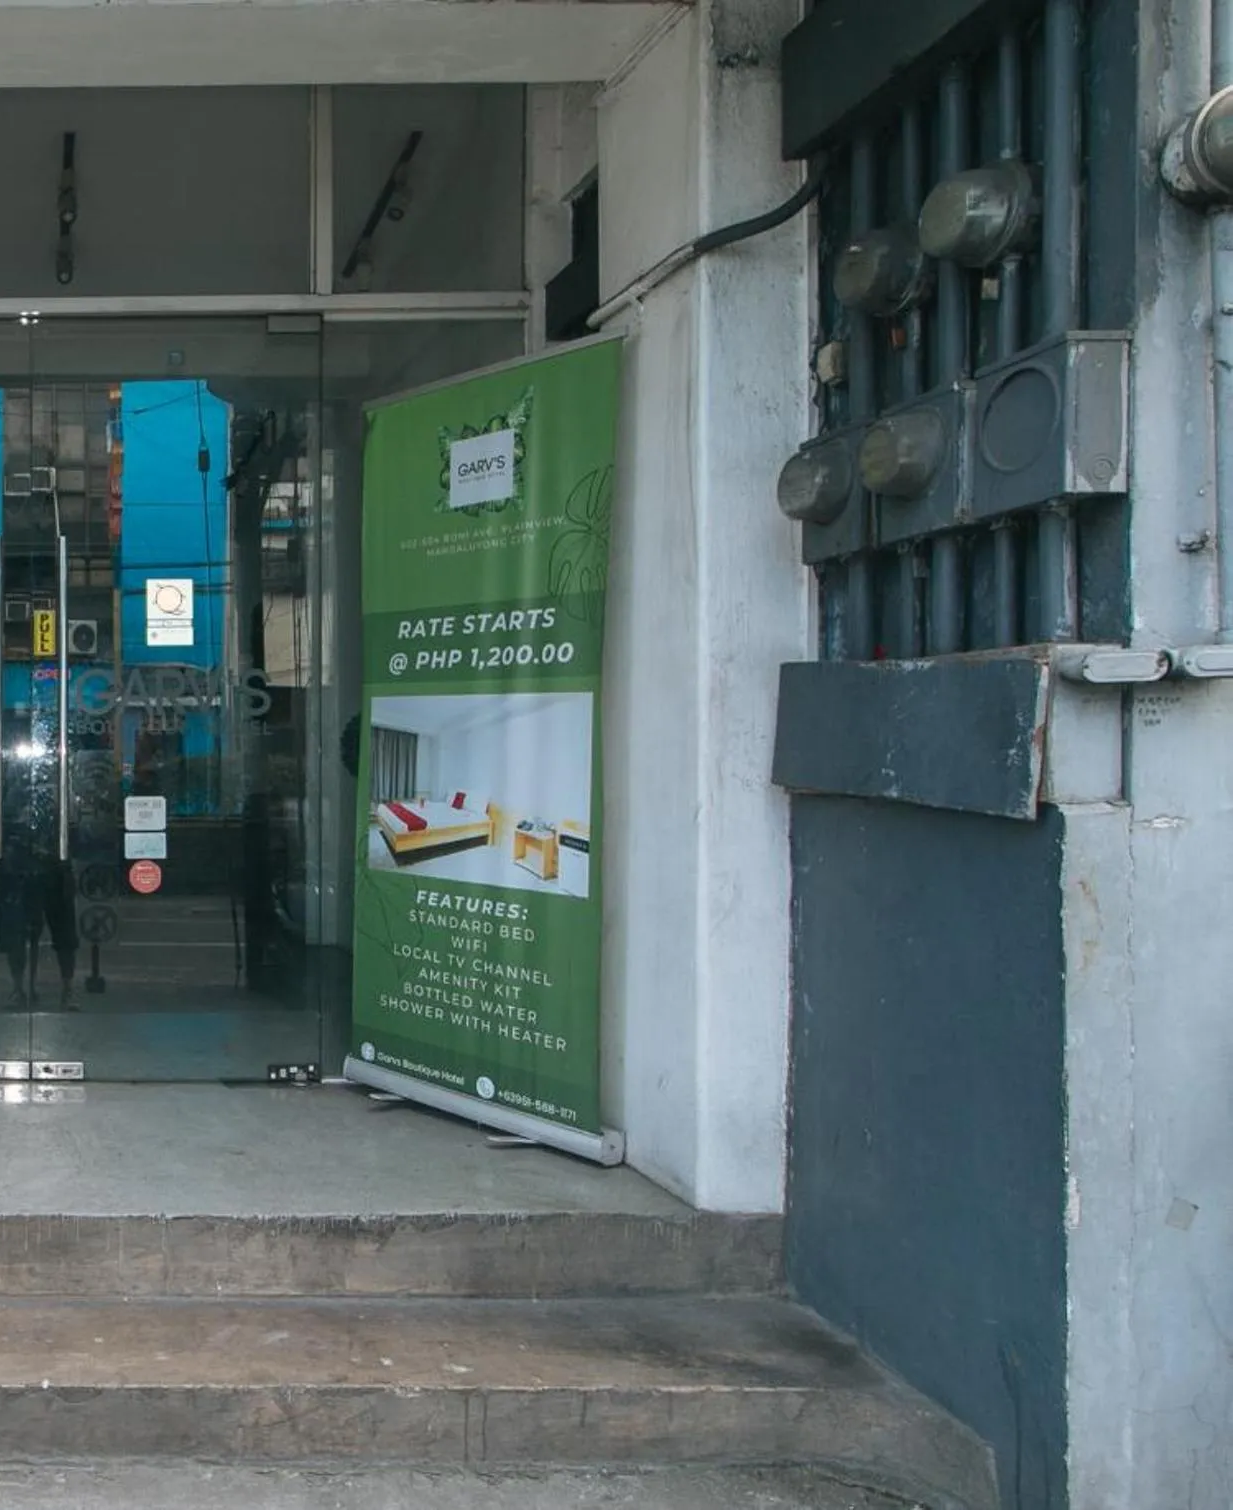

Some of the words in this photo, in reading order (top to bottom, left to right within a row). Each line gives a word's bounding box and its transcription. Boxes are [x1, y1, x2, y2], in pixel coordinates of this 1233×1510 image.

[39, 613, 50, 652] PULL
[397, 617, 455, 640] RATE
[462, 608, 556, 635] STARTS
[389, 653, 408, 675] @
[416, 649, 462, 670] PHP
[470, 642, 574, 670] 1,200.00
[416, 890, 528, 920] FEATURES:
[409, 909, 493, 934] STANDARD
[499, 925, 535, 941] BED
[452, 935, 487, 953] WIFI
[393, 943, 442, 965] LOCAL
[447, 954, 465, 968] TV
[472, 958, 554, 988] CHANNEL
[418, 967, 488, 990] AMENITY
[494, 982, 522, 1000] KIT
[403, 982, 473, 1009] BOTTLED
[480, 1000, 538, 1025] WATER
[380, 995, 444, 1021] SHOWER
[450, 1011, 491, 1033] WITH
[498, 1024, 567, 1052] HEATER
[402, 1059, 440, 1079] Boutique
[441, 1070, 465, 1086] Hotel
